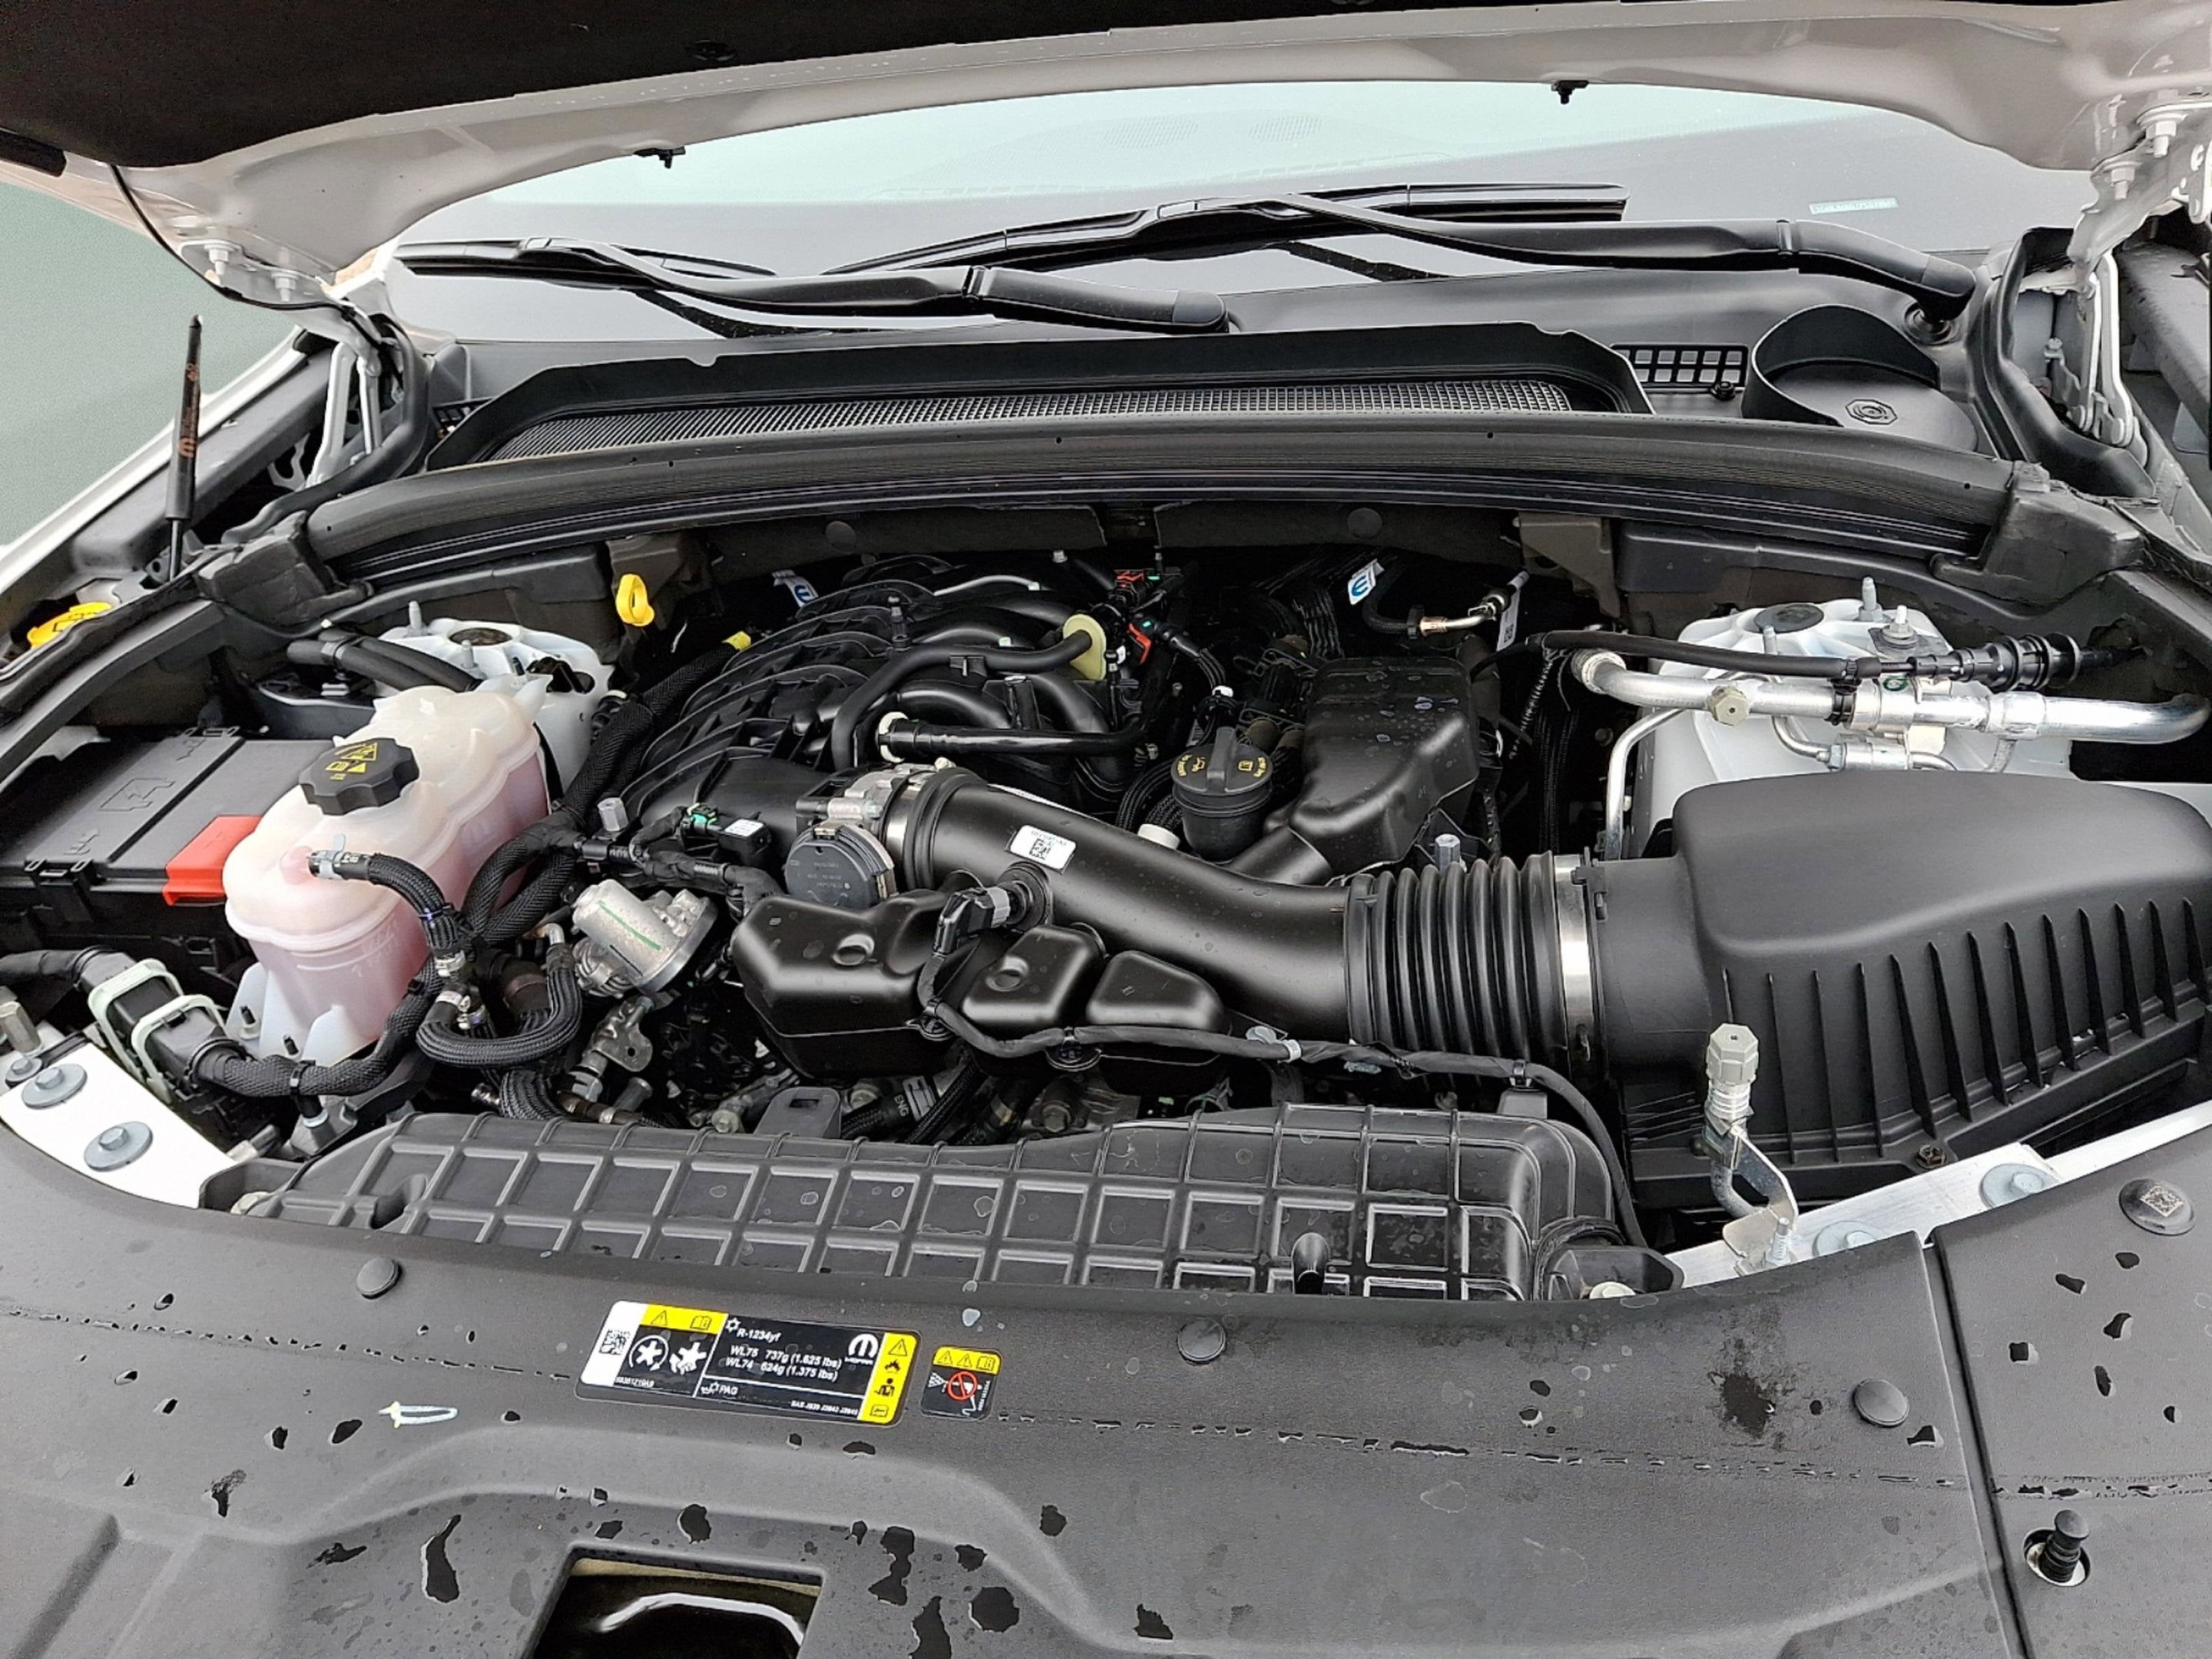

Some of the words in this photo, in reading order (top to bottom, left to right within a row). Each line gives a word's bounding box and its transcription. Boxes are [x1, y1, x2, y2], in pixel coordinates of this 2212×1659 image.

[736, 1327, 782, 1343] R-1234yf
[730, 1345, 759, 1357] WL75
[765, 1349, 790, 1364] 737g
[790, 1353, 821, 1366] (1.625
[822, 1356, 843, 1370] lbs)
[725, 1356, 754, 1370] WL74
[760, 1362, 786, 1376] 624g
[786, 1364, 818, 1378] (1.375
[817, 1369, 839, 1382] lbs)
[718, 1386, 738, 1396] PAG
